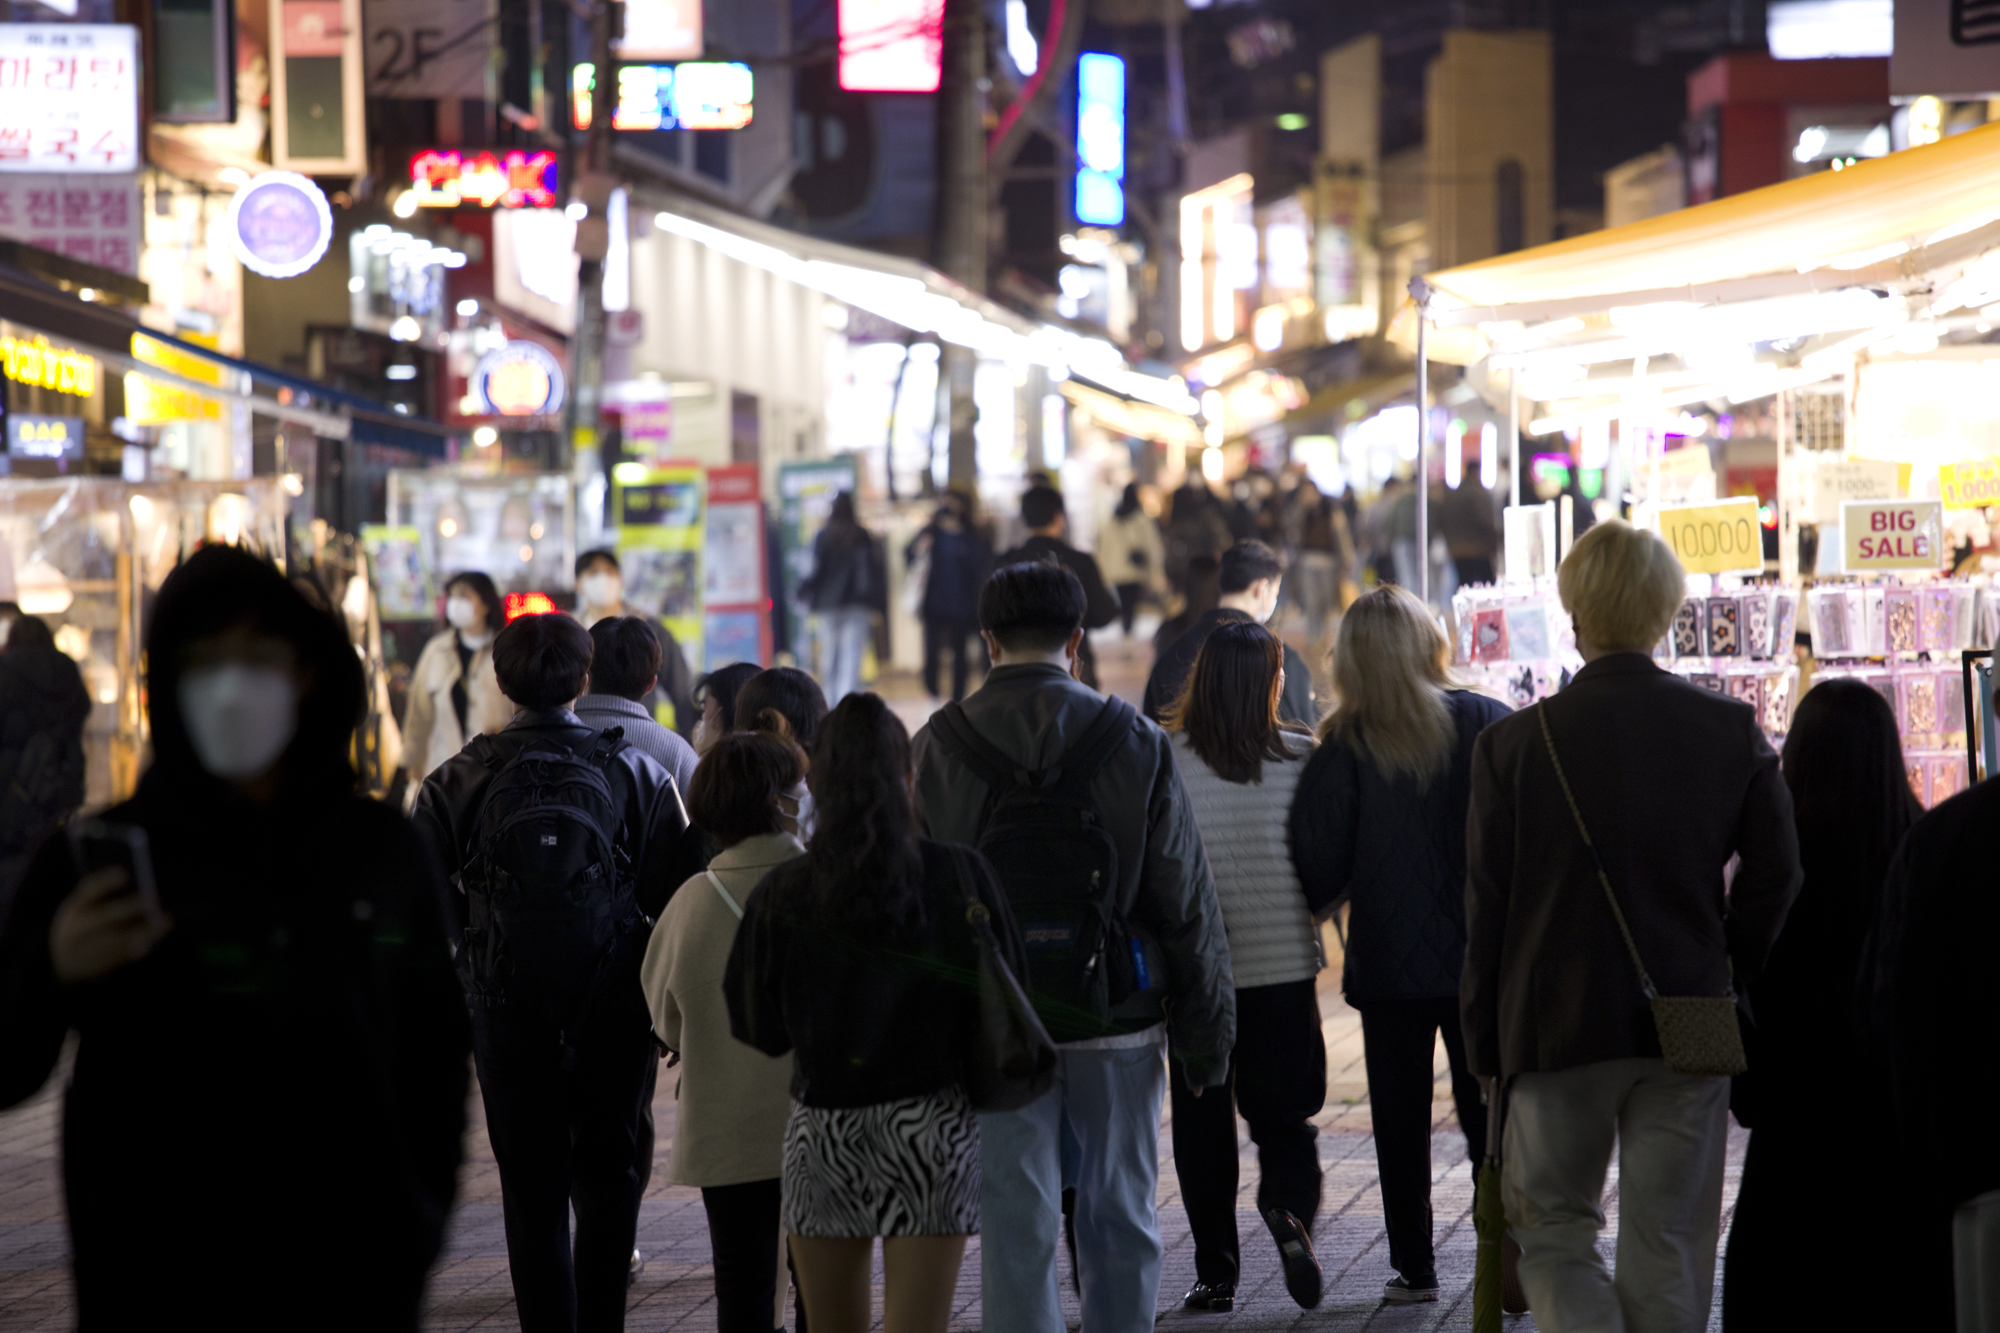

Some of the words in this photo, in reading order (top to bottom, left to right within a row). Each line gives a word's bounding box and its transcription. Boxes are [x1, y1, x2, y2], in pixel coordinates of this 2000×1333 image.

[373, 27, 442, 80] 2F
[1870, 510, 1916, 532] BIG
[1859, 536, 1928, 560] SALE
